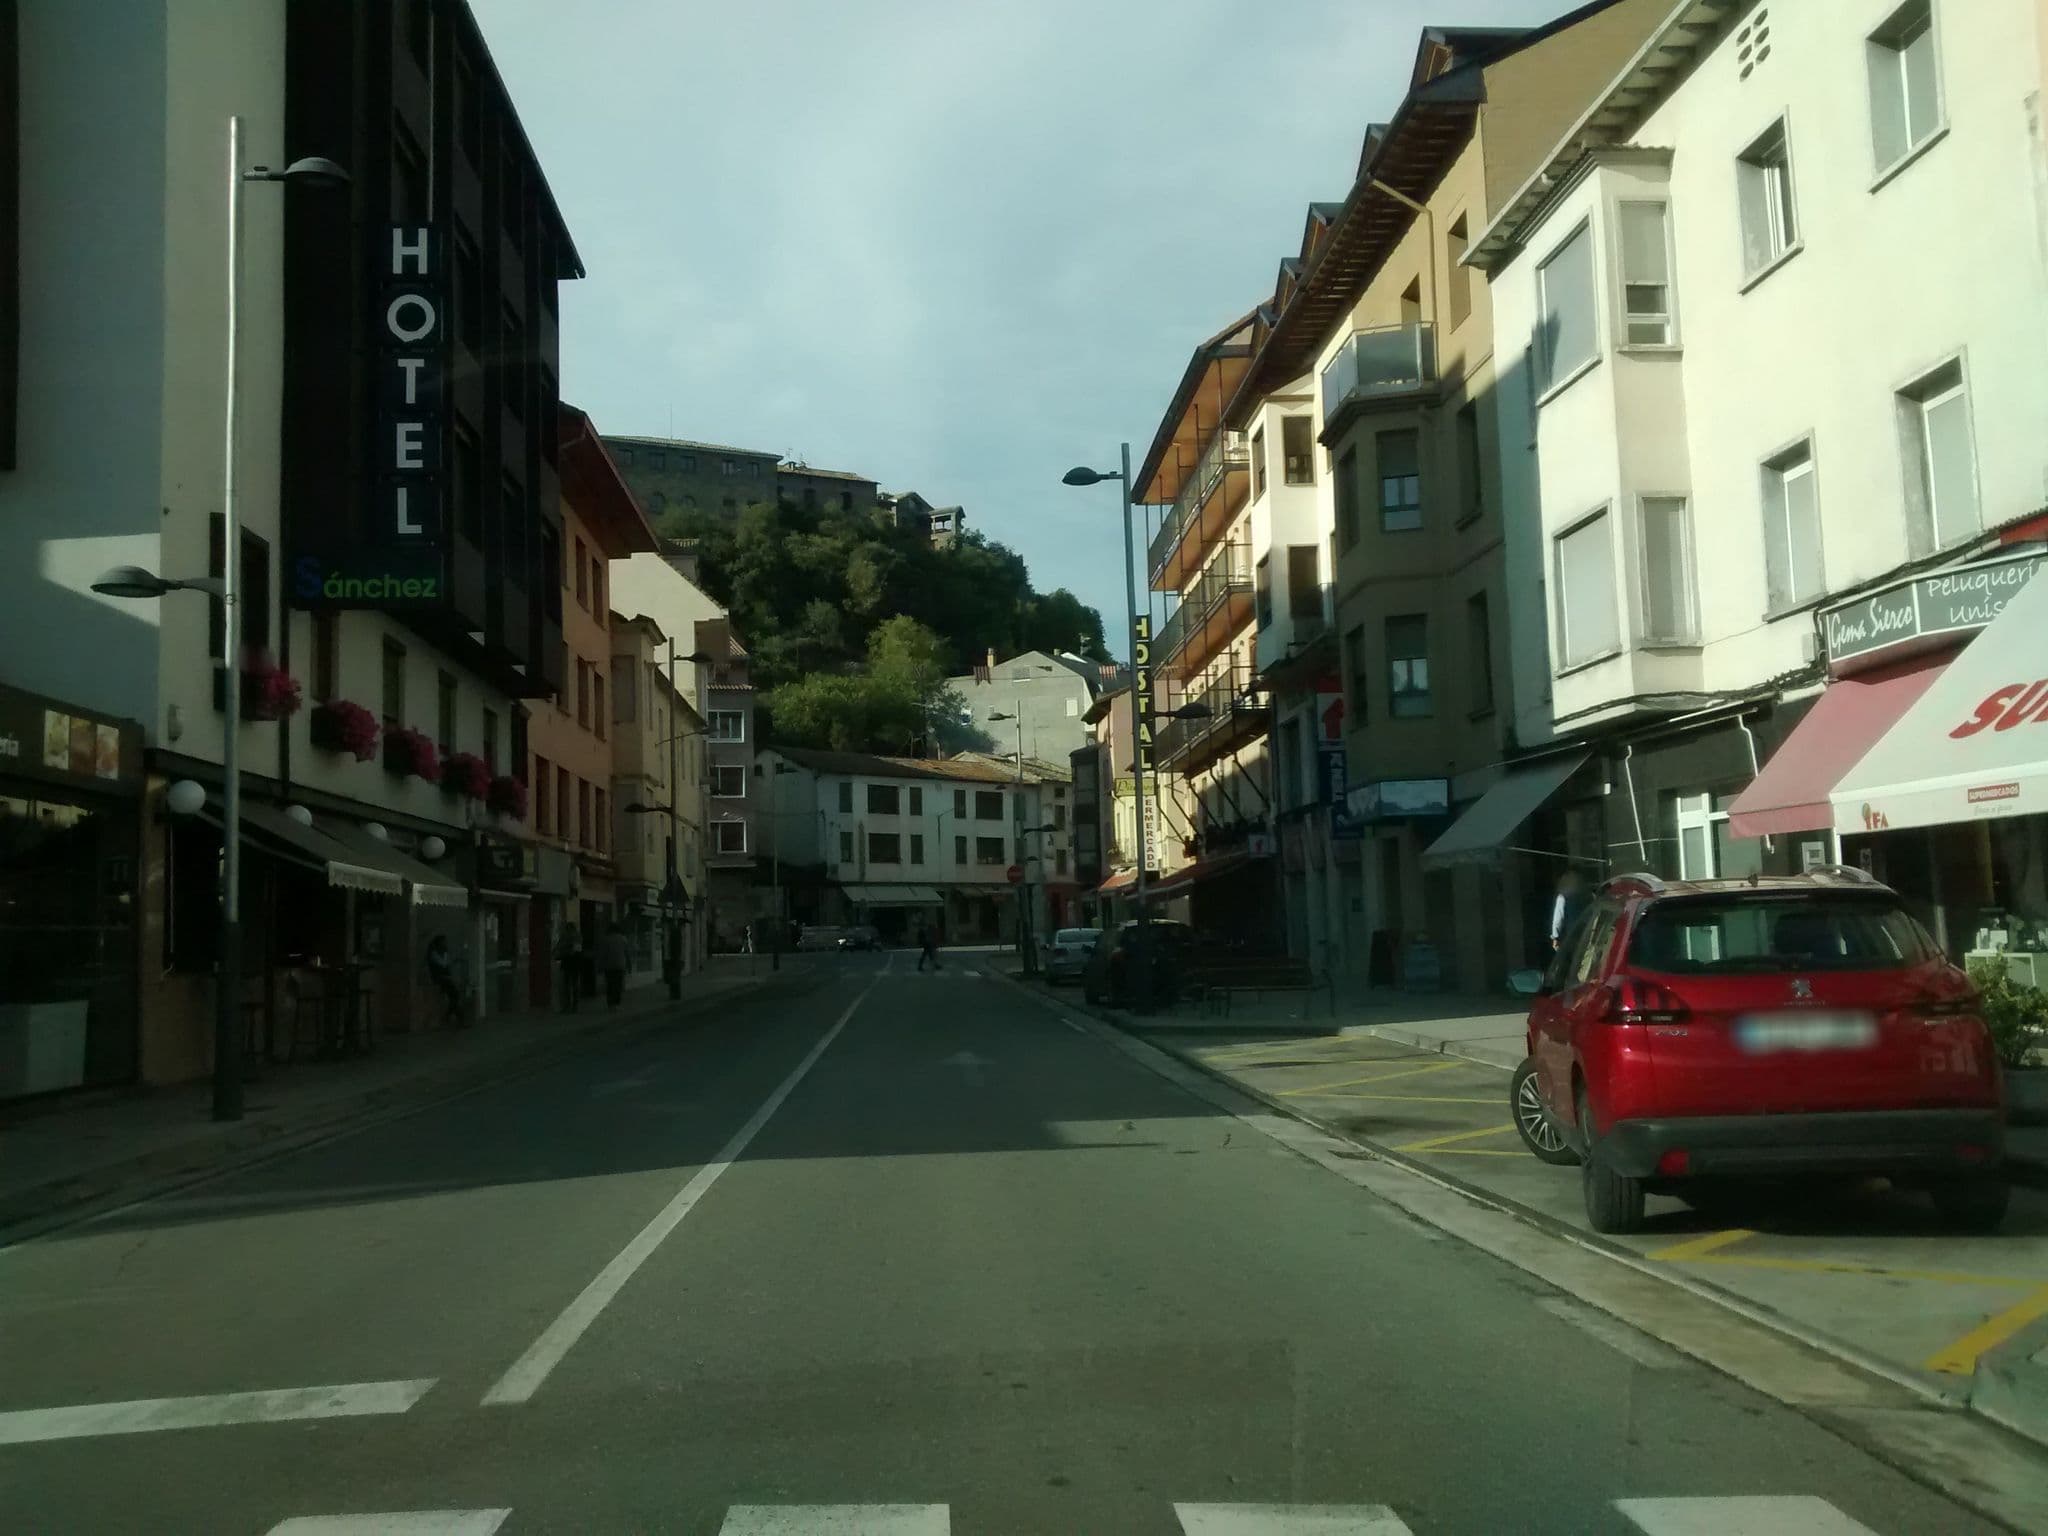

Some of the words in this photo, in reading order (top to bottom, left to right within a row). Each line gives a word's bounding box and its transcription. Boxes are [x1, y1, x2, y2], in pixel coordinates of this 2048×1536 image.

[386, 227, 436, 535] HOTEL
[296, 554, 437, 599] Sánchez
[1926, 558, 2035, 597] Peluquerí
[1831, 612, 1867, 654] Gema
[1136, 616, 1153, 769] HOSTAL
[1144, 798, 1155, 868] ERMERCADO
